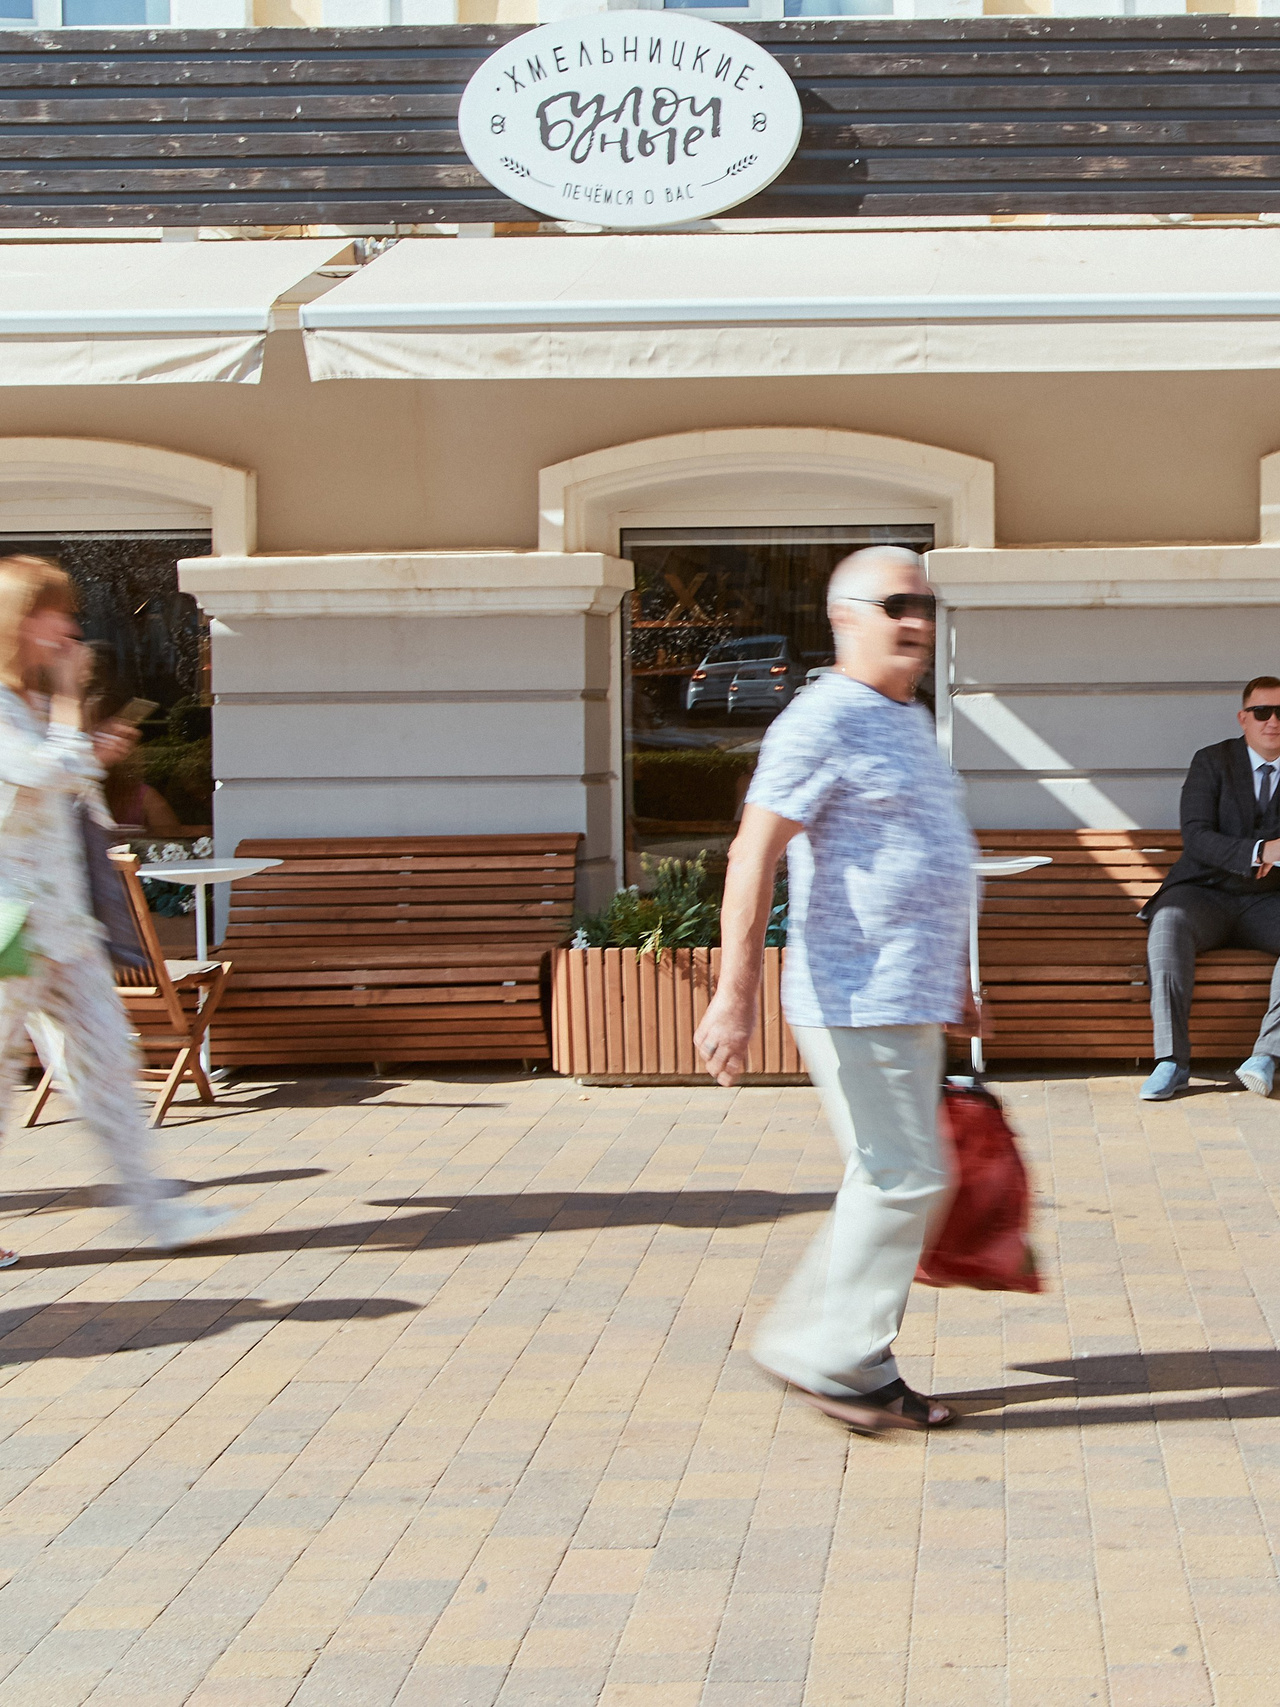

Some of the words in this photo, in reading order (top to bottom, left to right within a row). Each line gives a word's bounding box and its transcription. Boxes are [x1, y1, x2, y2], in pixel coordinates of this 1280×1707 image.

[503, 36, 755, 93] ХМЕЛЬНИЦКИЕ
[562, 182, 634, 206] ПЕЧЁМСЯ
[644, 189, 655, 205] О
[665, 183, 696, 203] ВАС
